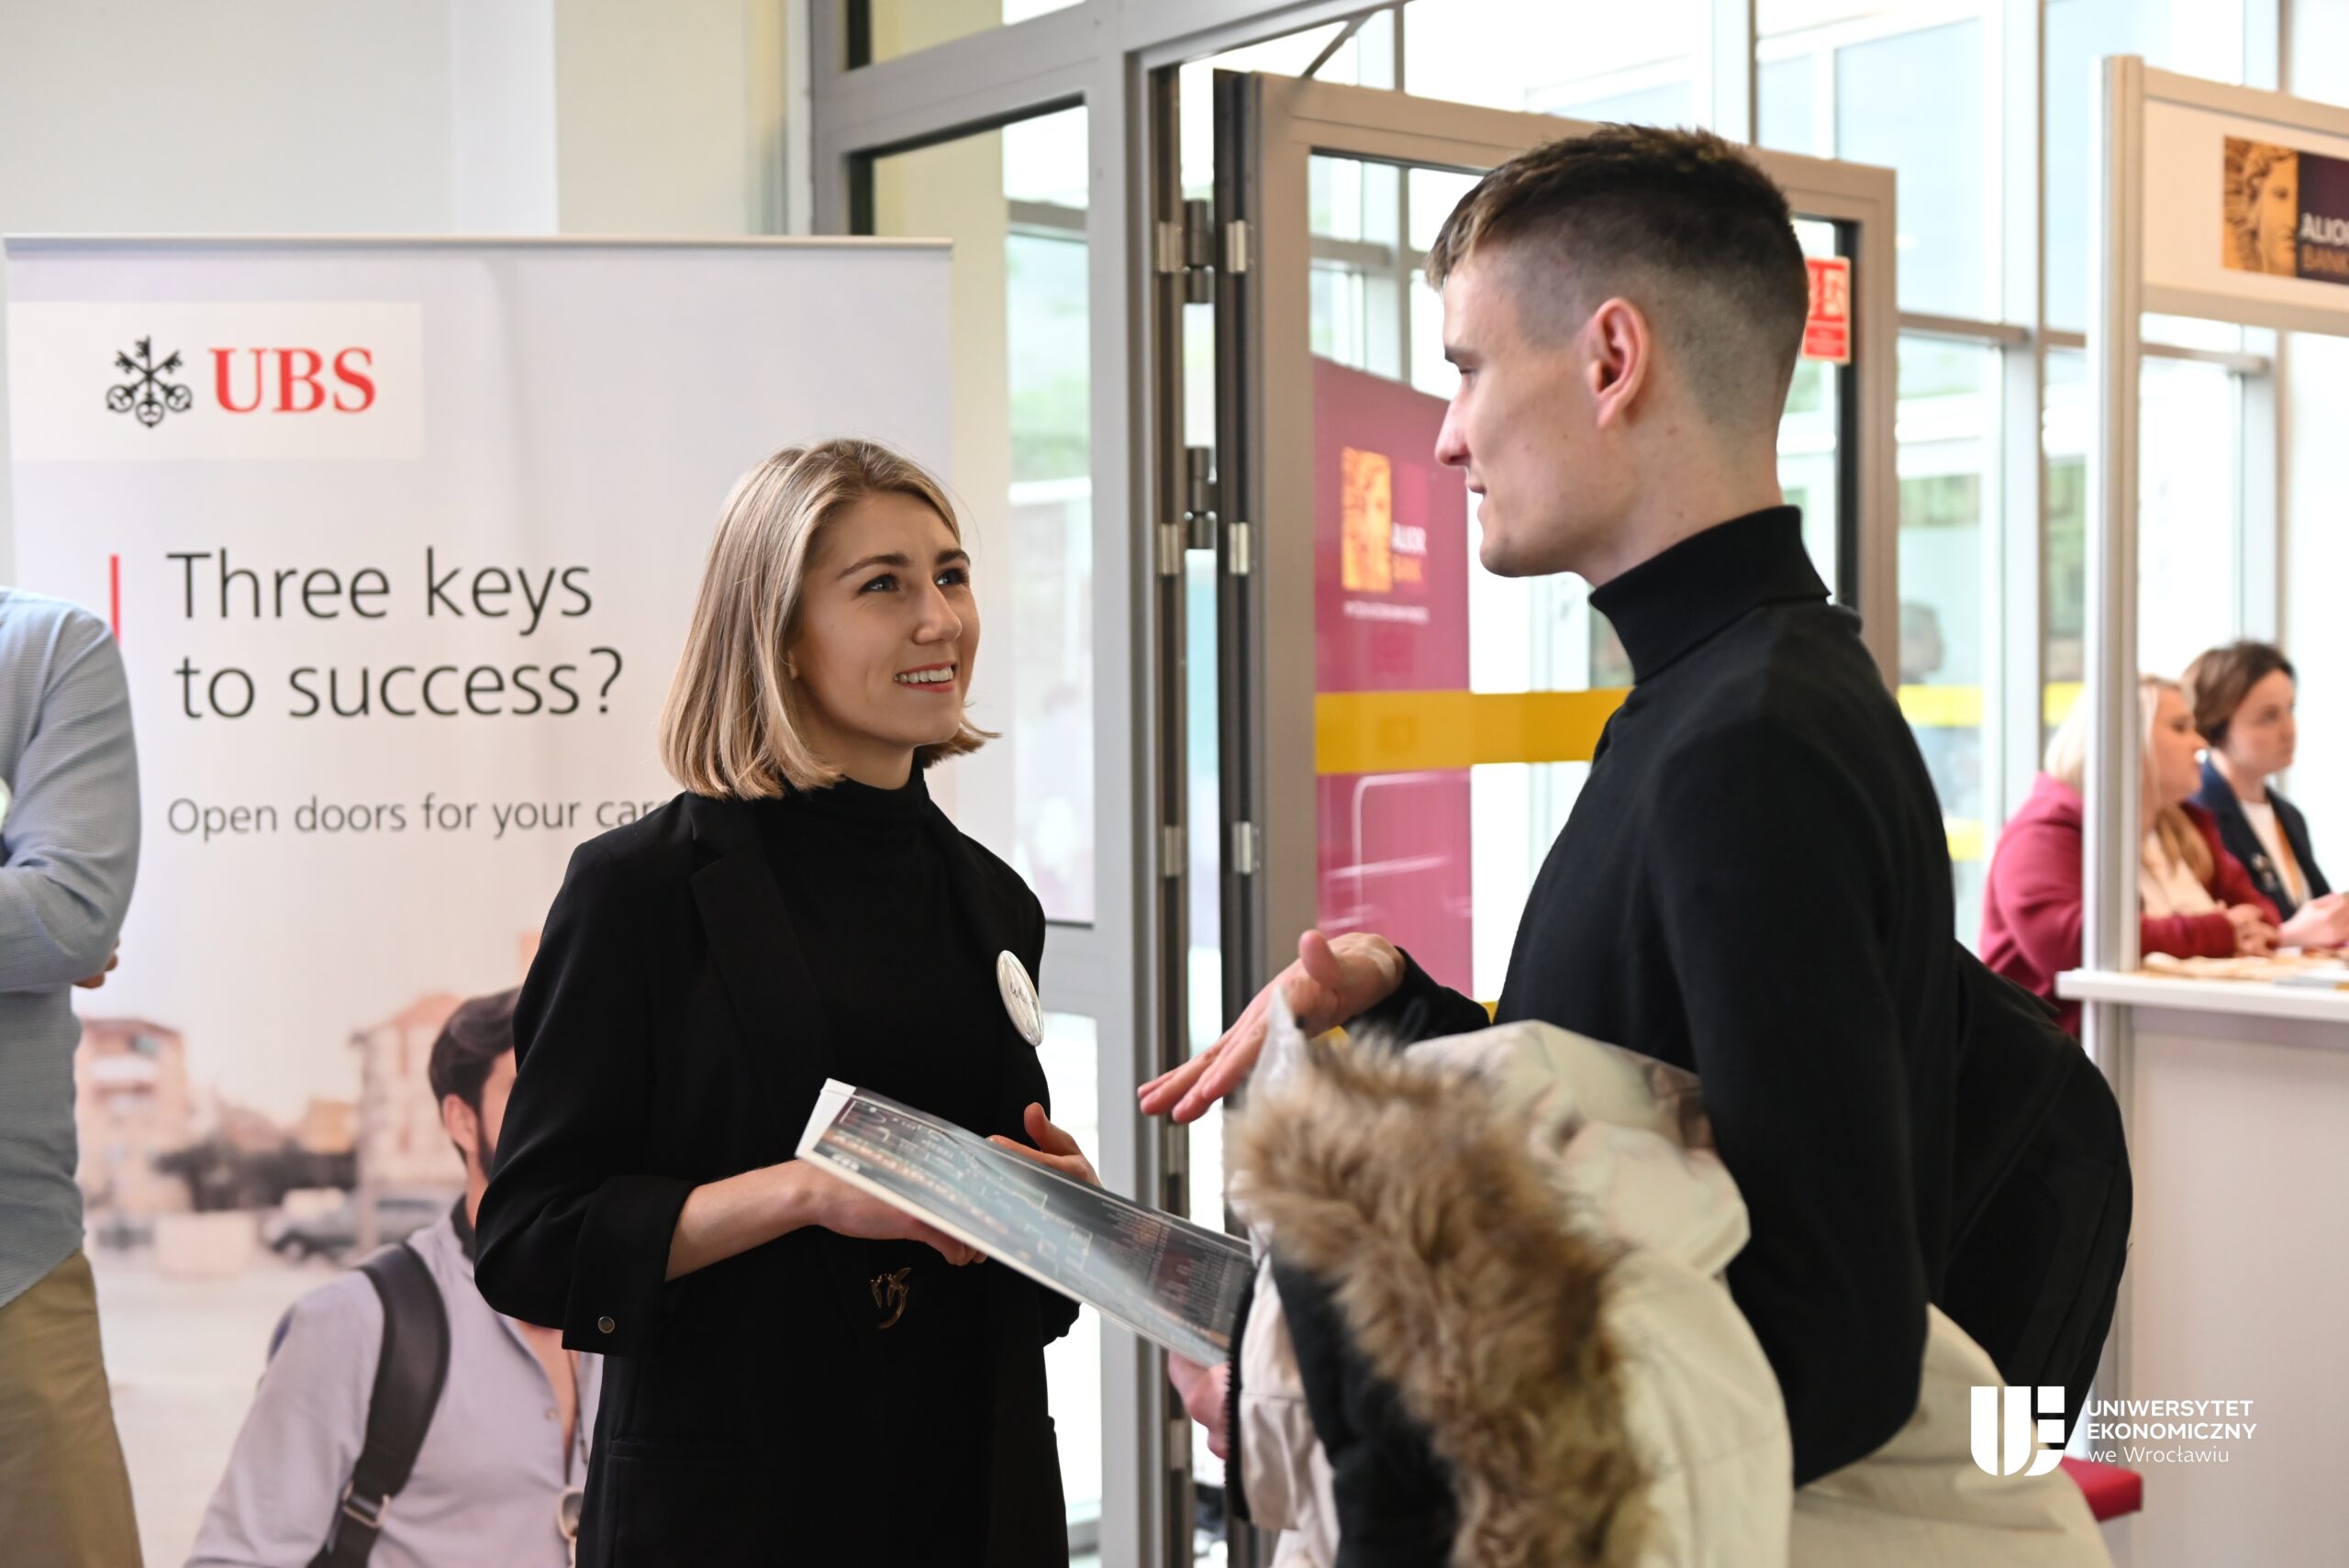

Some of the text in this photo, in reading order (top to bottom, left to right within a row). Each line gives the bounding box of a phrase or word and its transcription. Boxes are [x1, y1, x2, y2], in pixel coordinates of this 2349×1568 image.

[2299, 212, 2349, 247] ALIO
[208, 347, 378, 414] UBS
[165, 546, 593, 637] Three keys
[174, 646, 624, 719] to success?
[167, 793, 670, 843] Open doors for your car
